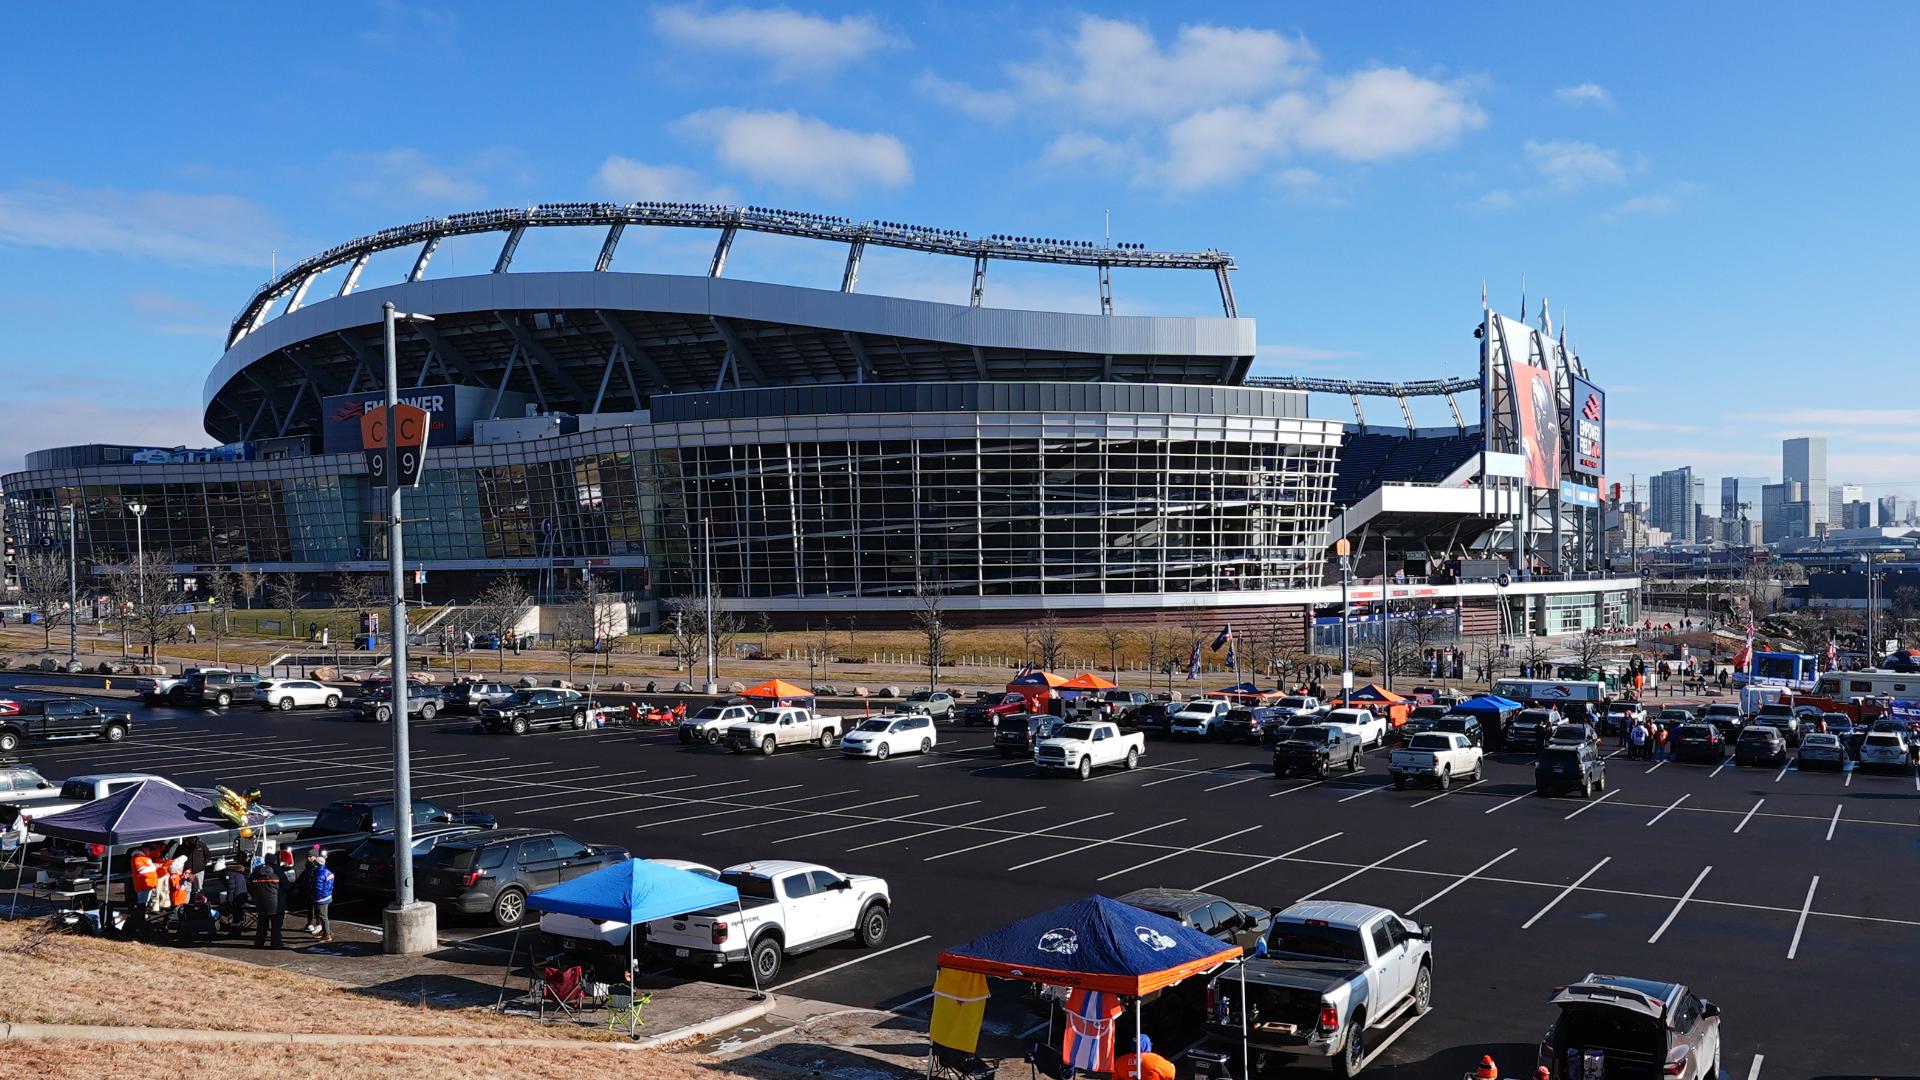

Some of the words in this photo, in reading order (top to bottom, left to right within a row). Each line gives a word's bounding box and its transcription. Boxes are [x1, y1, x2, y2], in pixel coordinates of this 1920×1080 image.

[371, 421, 383, 442] C
[400, 418, 415, 440] C
[373, 454, 383, 476] 9
[402, 453, 415, 475] 9
[1500, 576, 1508, 585] 10
[1023, 971, 1083, 987] BRONCOS
